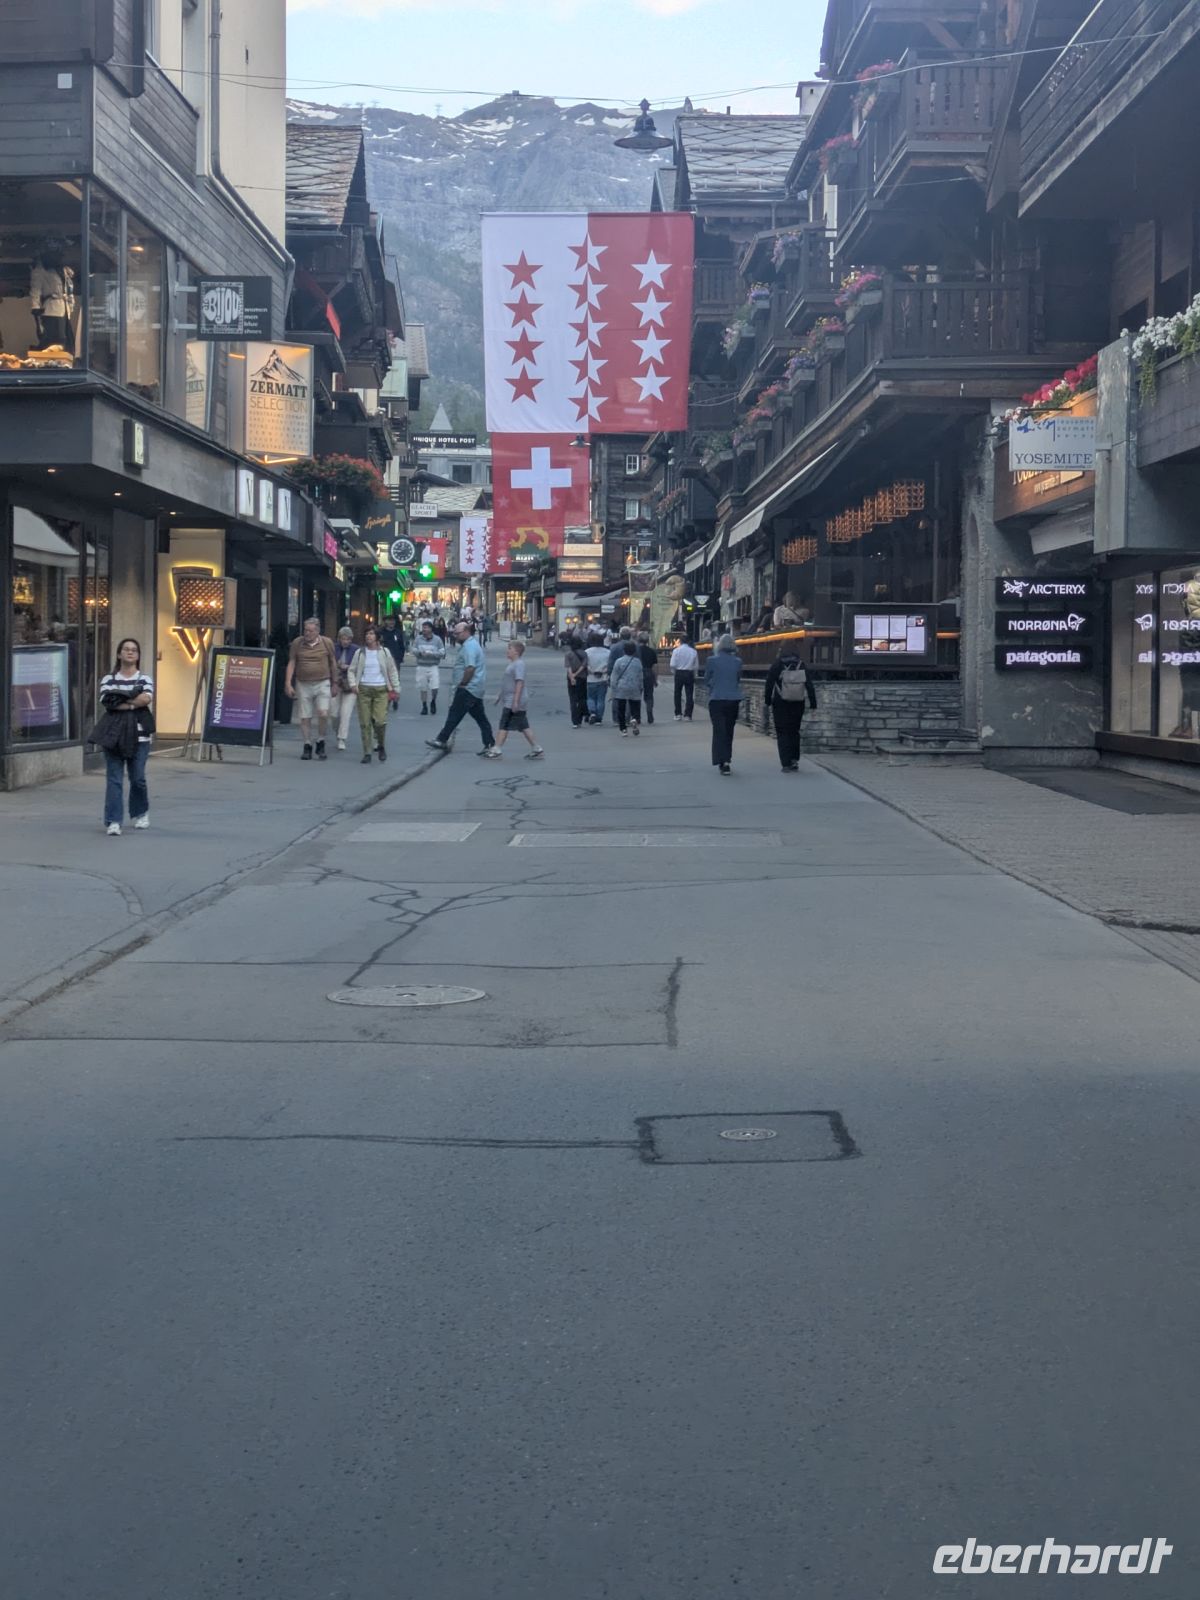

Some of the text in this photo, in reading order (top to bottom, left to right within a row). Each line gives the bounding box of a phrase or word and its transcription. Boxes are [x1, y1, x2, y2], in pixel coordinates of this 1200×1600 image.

[202, 287, 241, 324] BIJOU
[250, 379, 308, 398] ZERMATT
[249, 396, 308, 413] SELECTION
[1015, 453, 1093, 465] YOSEMITE
[1008, 620, 1068, 631] NORRØNA
[1006, 650, 1081, 666] patagonia
[213, 690, 223, 724] NENAD
